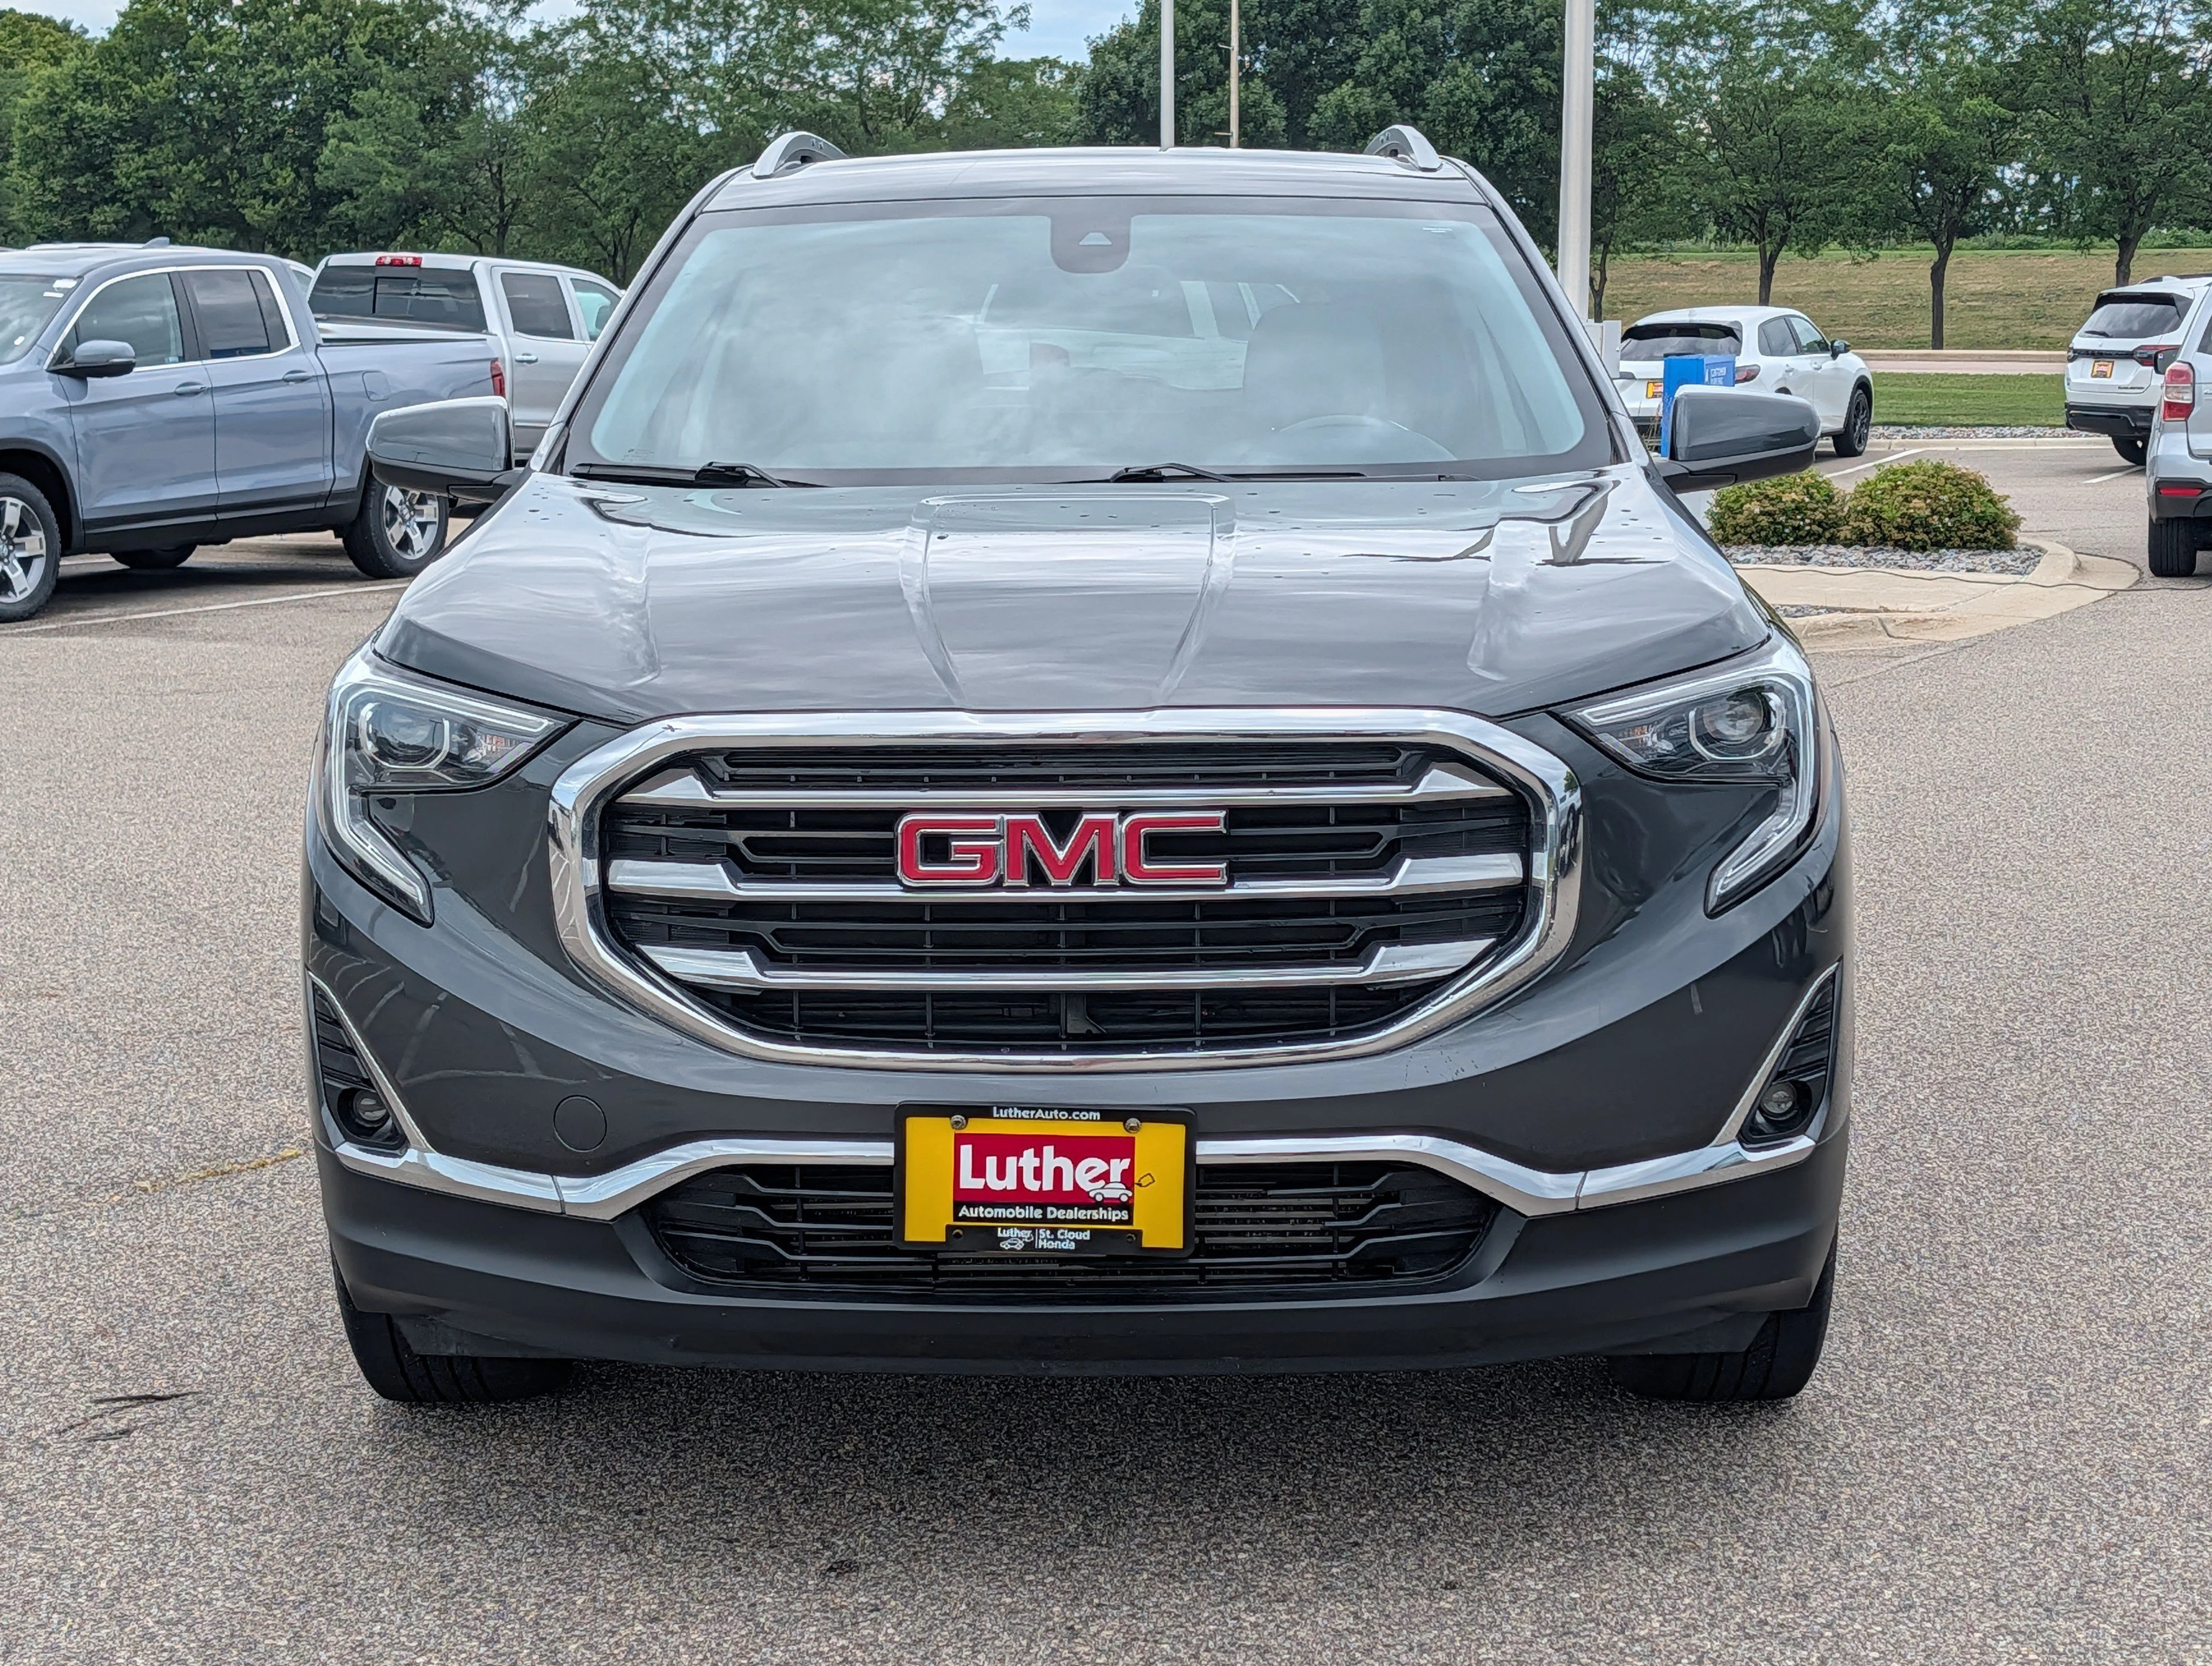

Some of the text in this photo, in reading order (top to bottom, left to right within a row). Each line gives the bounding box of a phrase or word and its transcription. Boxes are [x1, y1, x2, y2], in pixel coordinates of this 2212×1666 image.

[897, 811, 1229, 887] GMC
[993, 1106, 1101, 1120] LutherAuto.com
[959, 1144, 1130, 1192] Luther
[958, 1205, 1129, 1222] Automobile Dealerships
[997, 1227, 1032, 1238] Luther
[1039, 1228, 1091, 1240] St. Cloud
[1038, 1239, 1075, 1250] Honda
